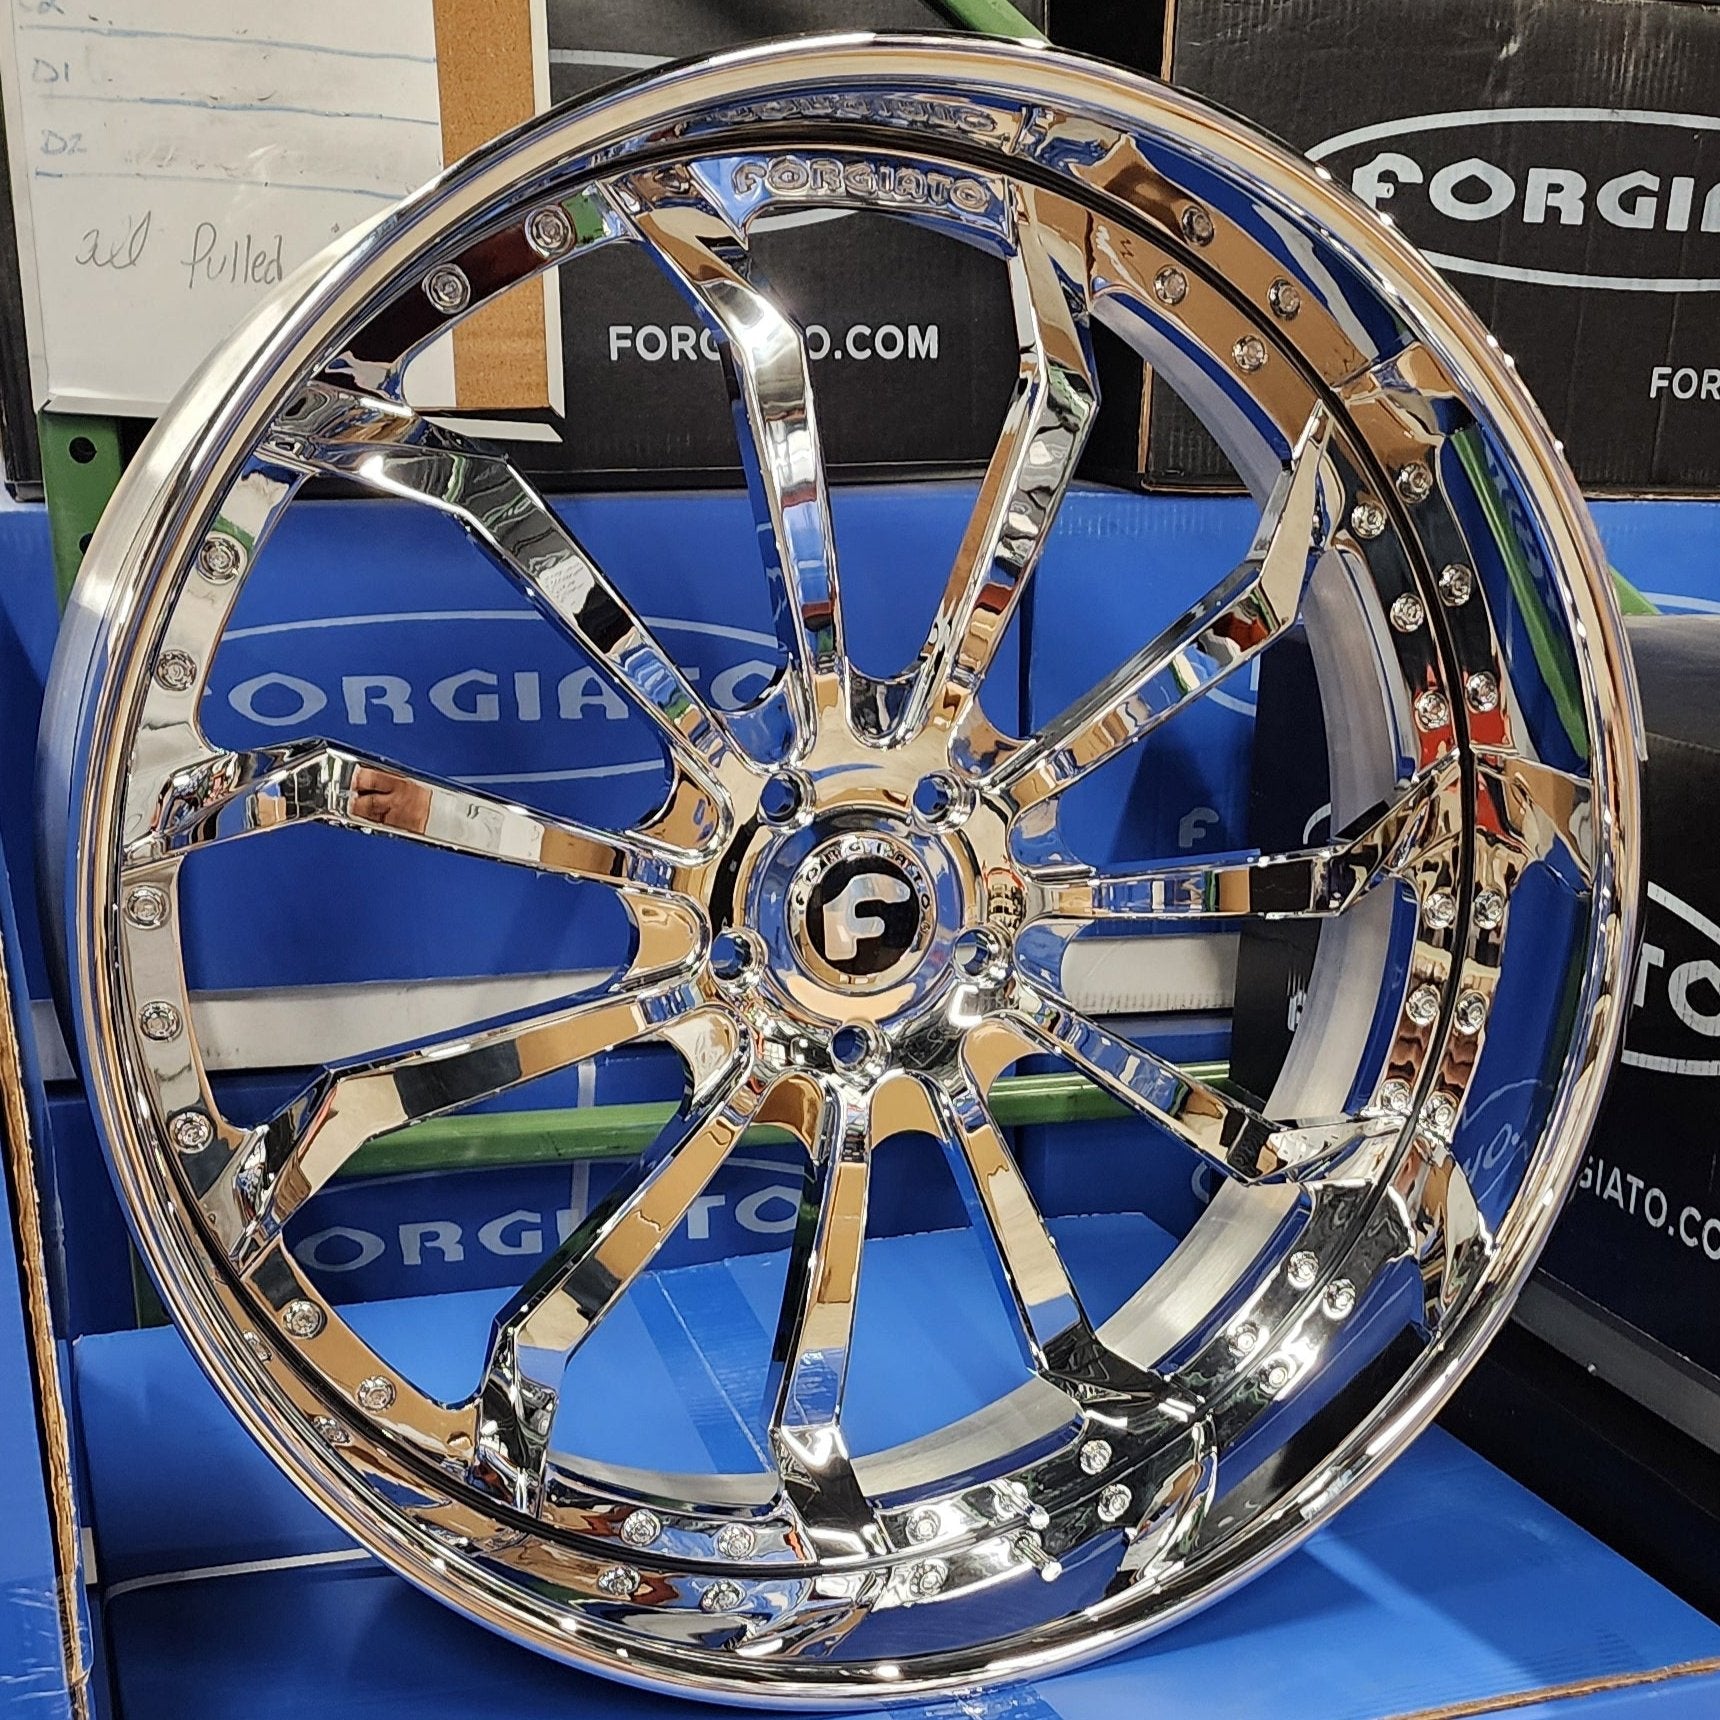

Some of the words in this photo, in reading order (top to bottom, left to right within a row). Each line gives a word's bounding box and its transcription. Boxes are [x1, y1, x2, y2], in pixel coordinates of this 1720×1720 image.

[732, 155, 990, 213] FORGIATO
[1352, 153, 1720, 232] FORGI
[609, 325, 939, 361] FORO.COM
[204, 660, 777, 726] ORGIAO
[823, 873, 911, 960] F
